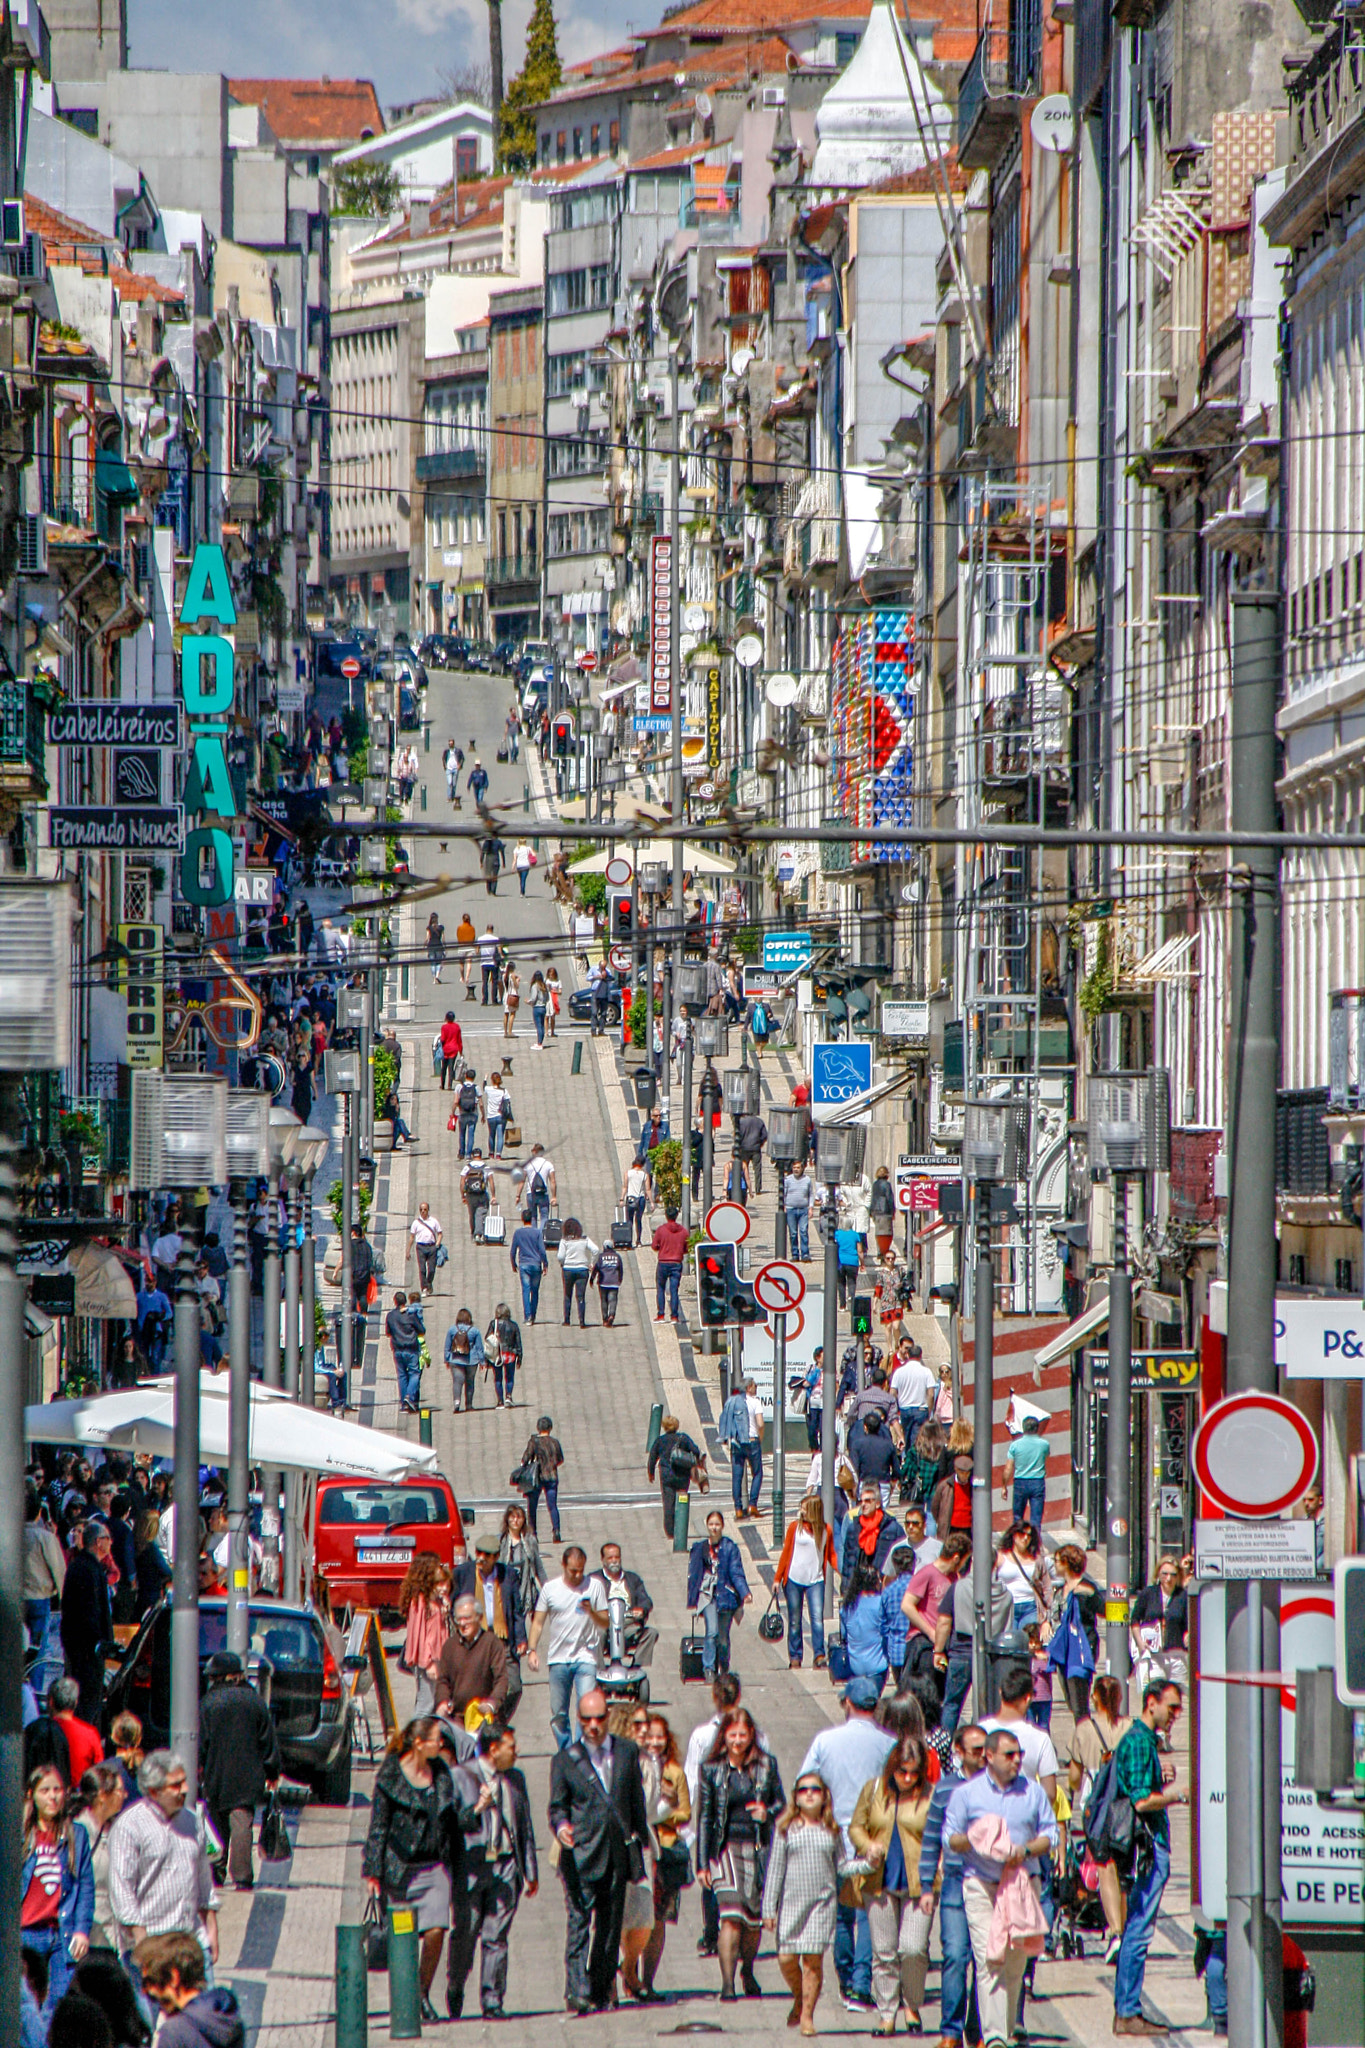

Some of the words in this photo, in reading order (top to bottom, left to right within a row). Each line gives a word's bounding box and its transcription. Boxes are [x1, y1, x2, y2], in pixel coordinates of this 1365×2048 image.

[51, 707, 176, 744] Cabeleireiros
[179, 544, 238, 907] ADÃO
[51, 812, 125, 846] Fernando
[129, 817, 180, 846] Nunes
[234, 877, 268, 901] AR
[820, 1085, 862, 1099] YOGA
[1146, 1357, 1199, 1385] Lay
[1288, 1795, 1313, 1805] DIAS
[1317, 1847, 1325, 1858] E
[1296, 1882, 1326, 1902] DE
